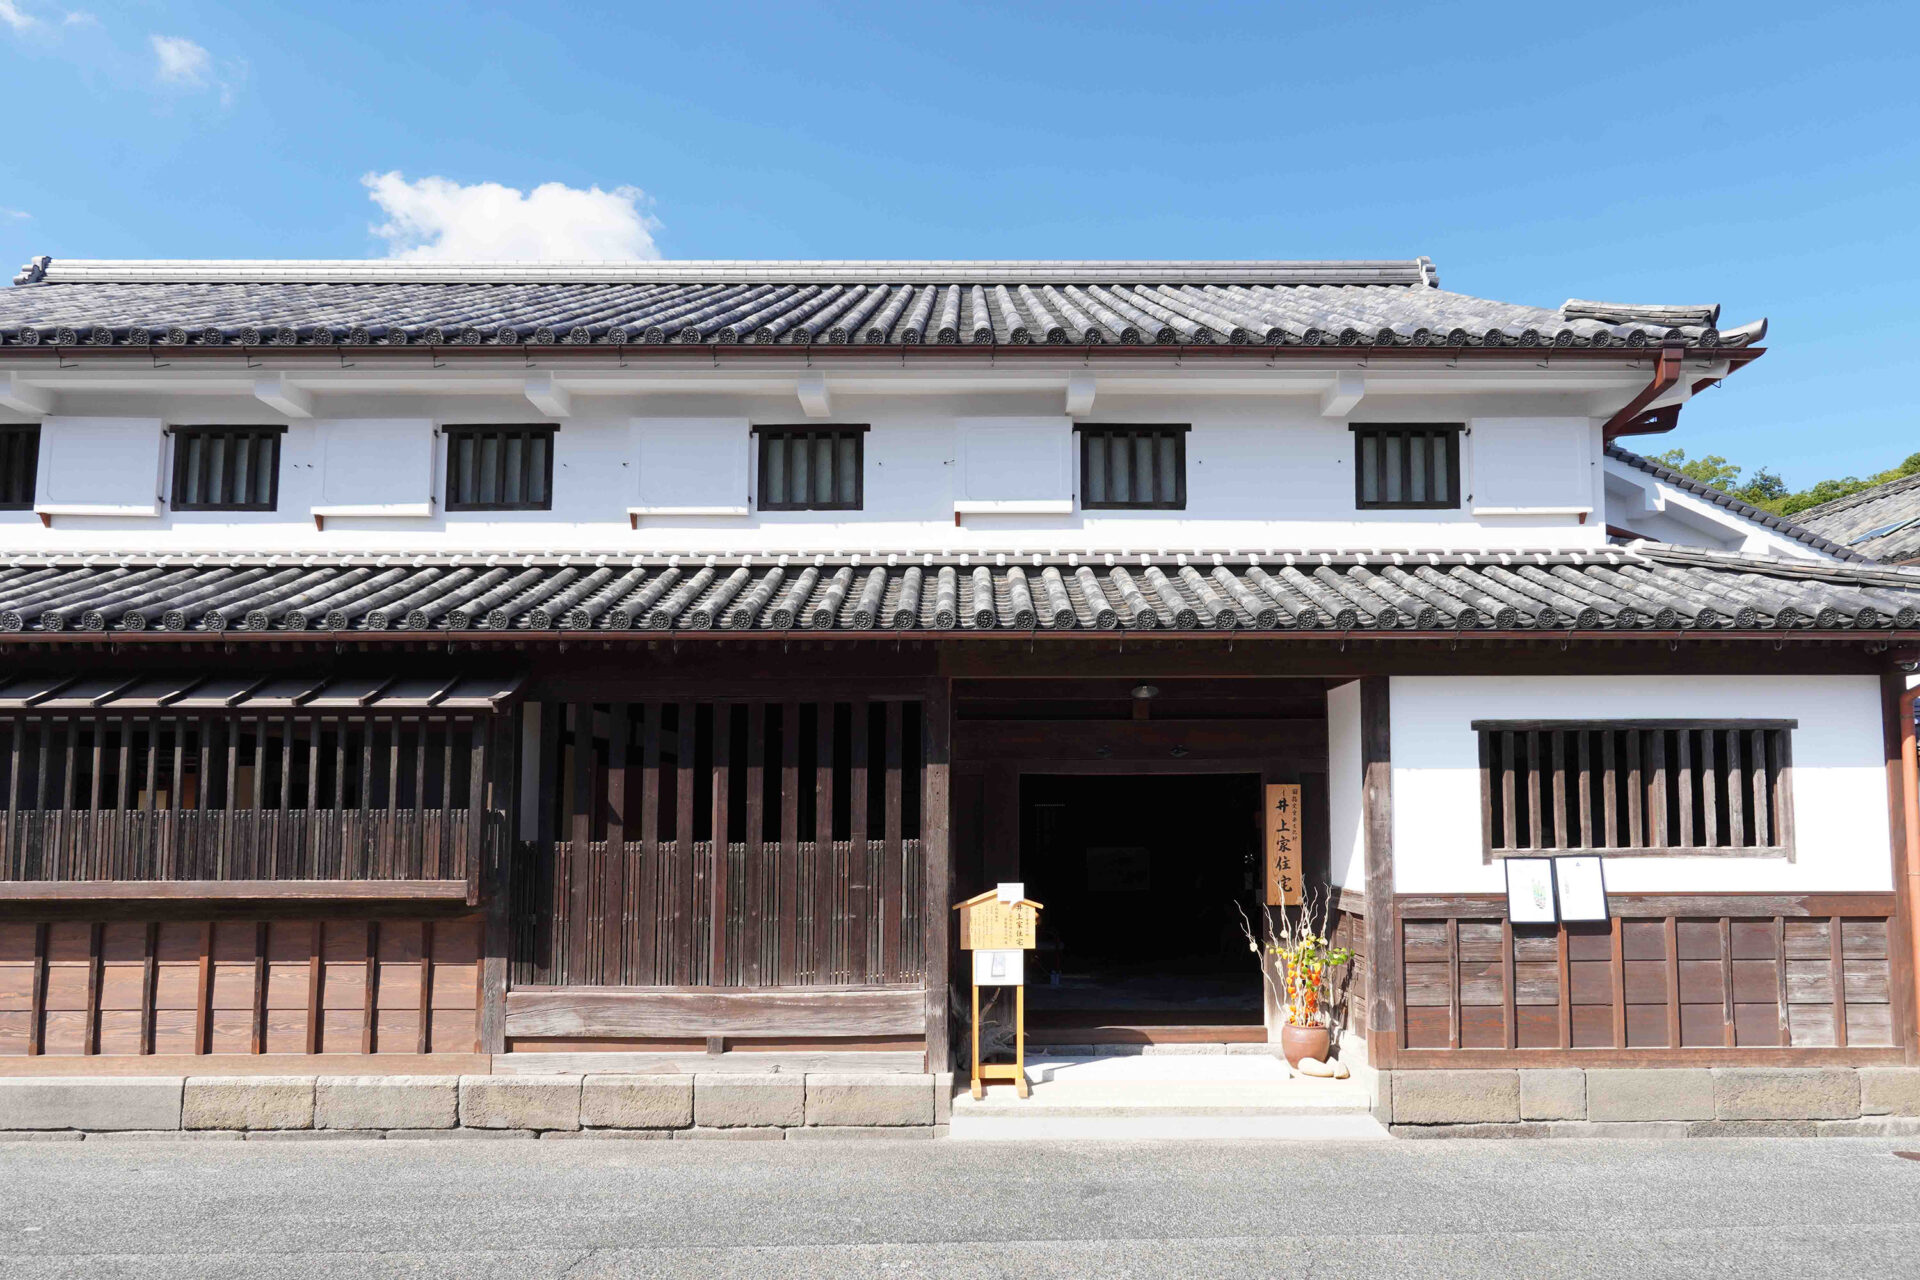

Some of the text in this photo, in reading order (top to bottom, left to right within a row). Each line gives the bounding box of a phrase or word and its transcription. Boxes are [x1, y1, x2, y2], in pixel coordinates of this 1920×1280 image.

[1275, 797, 1293, 893] 井上家住宅
[1016, 903, 1024, 946] 井上家住宅
